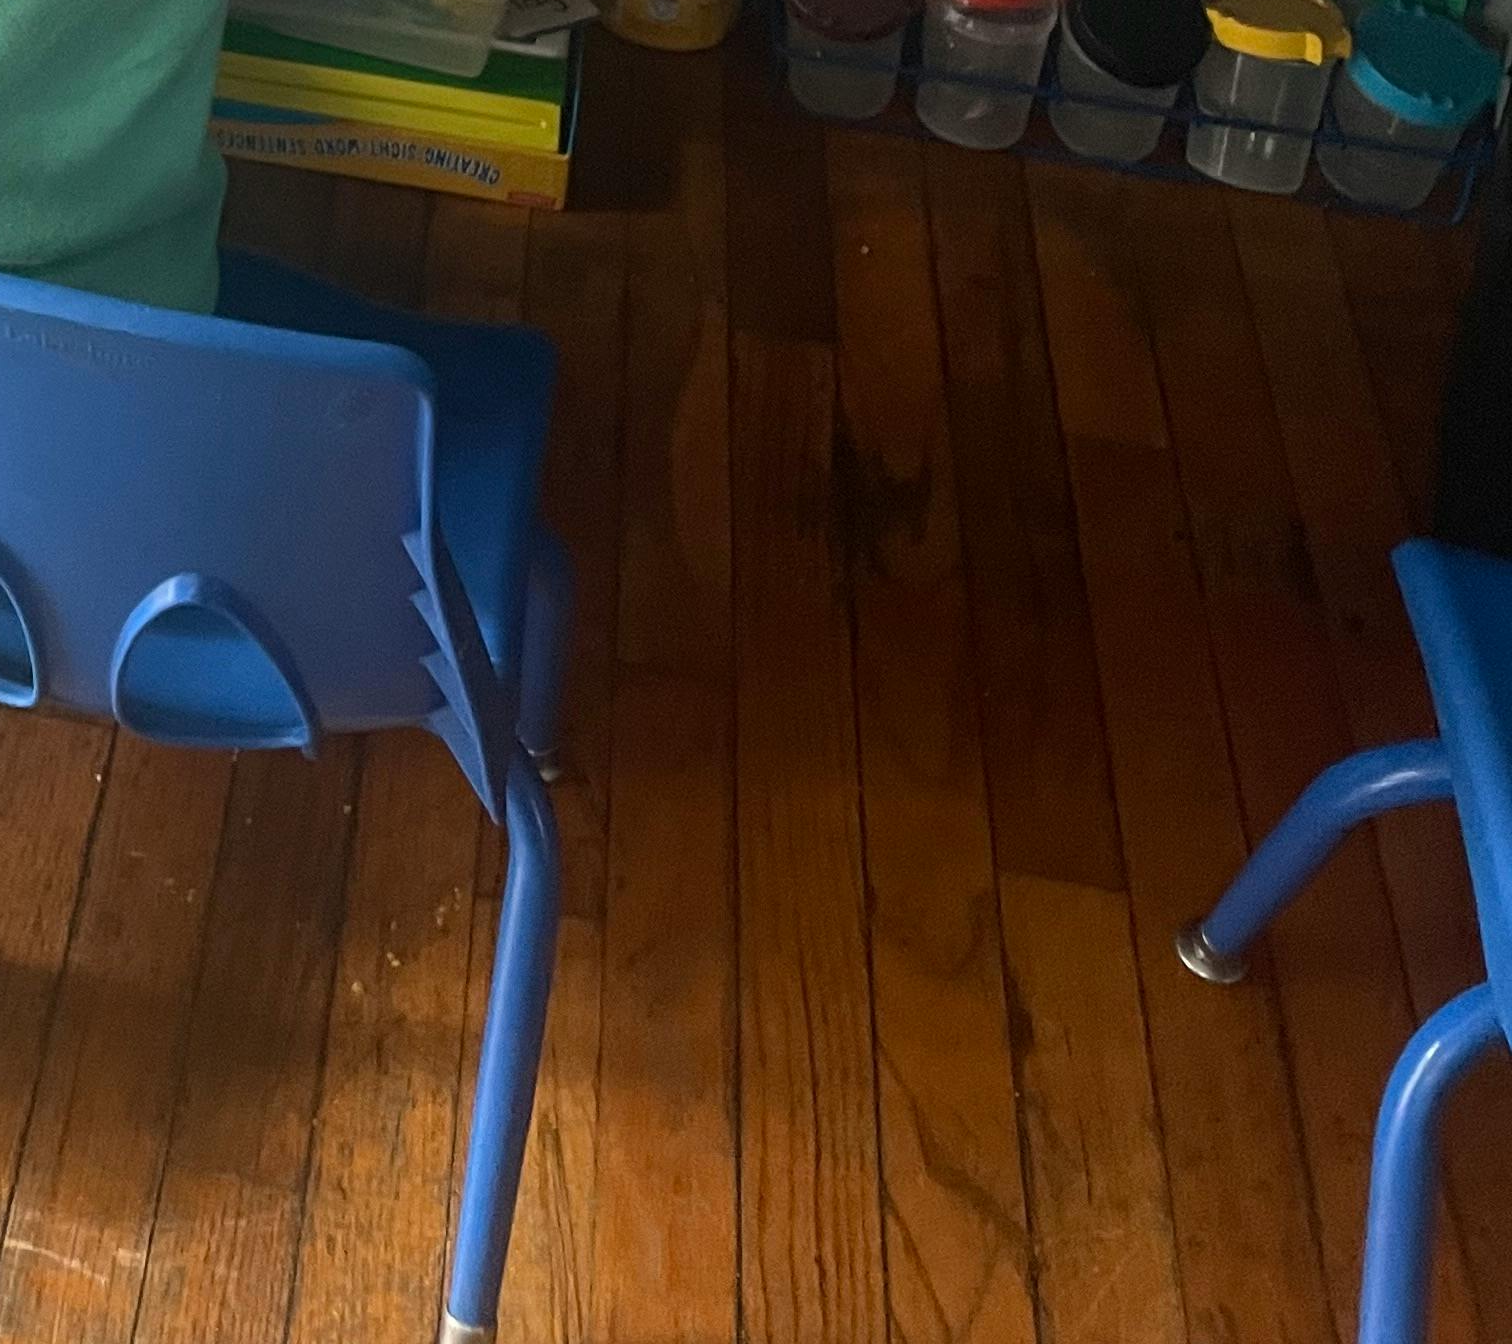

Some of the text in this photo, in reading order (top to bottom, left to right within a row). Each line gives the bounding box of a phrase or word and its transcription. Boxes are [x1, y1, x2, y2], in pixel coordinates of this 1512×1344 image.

[313, 135, 361, 155] WORD
[371, 140, 418, 160] SIGHT
[424, 150, 501, 185] CREATING
